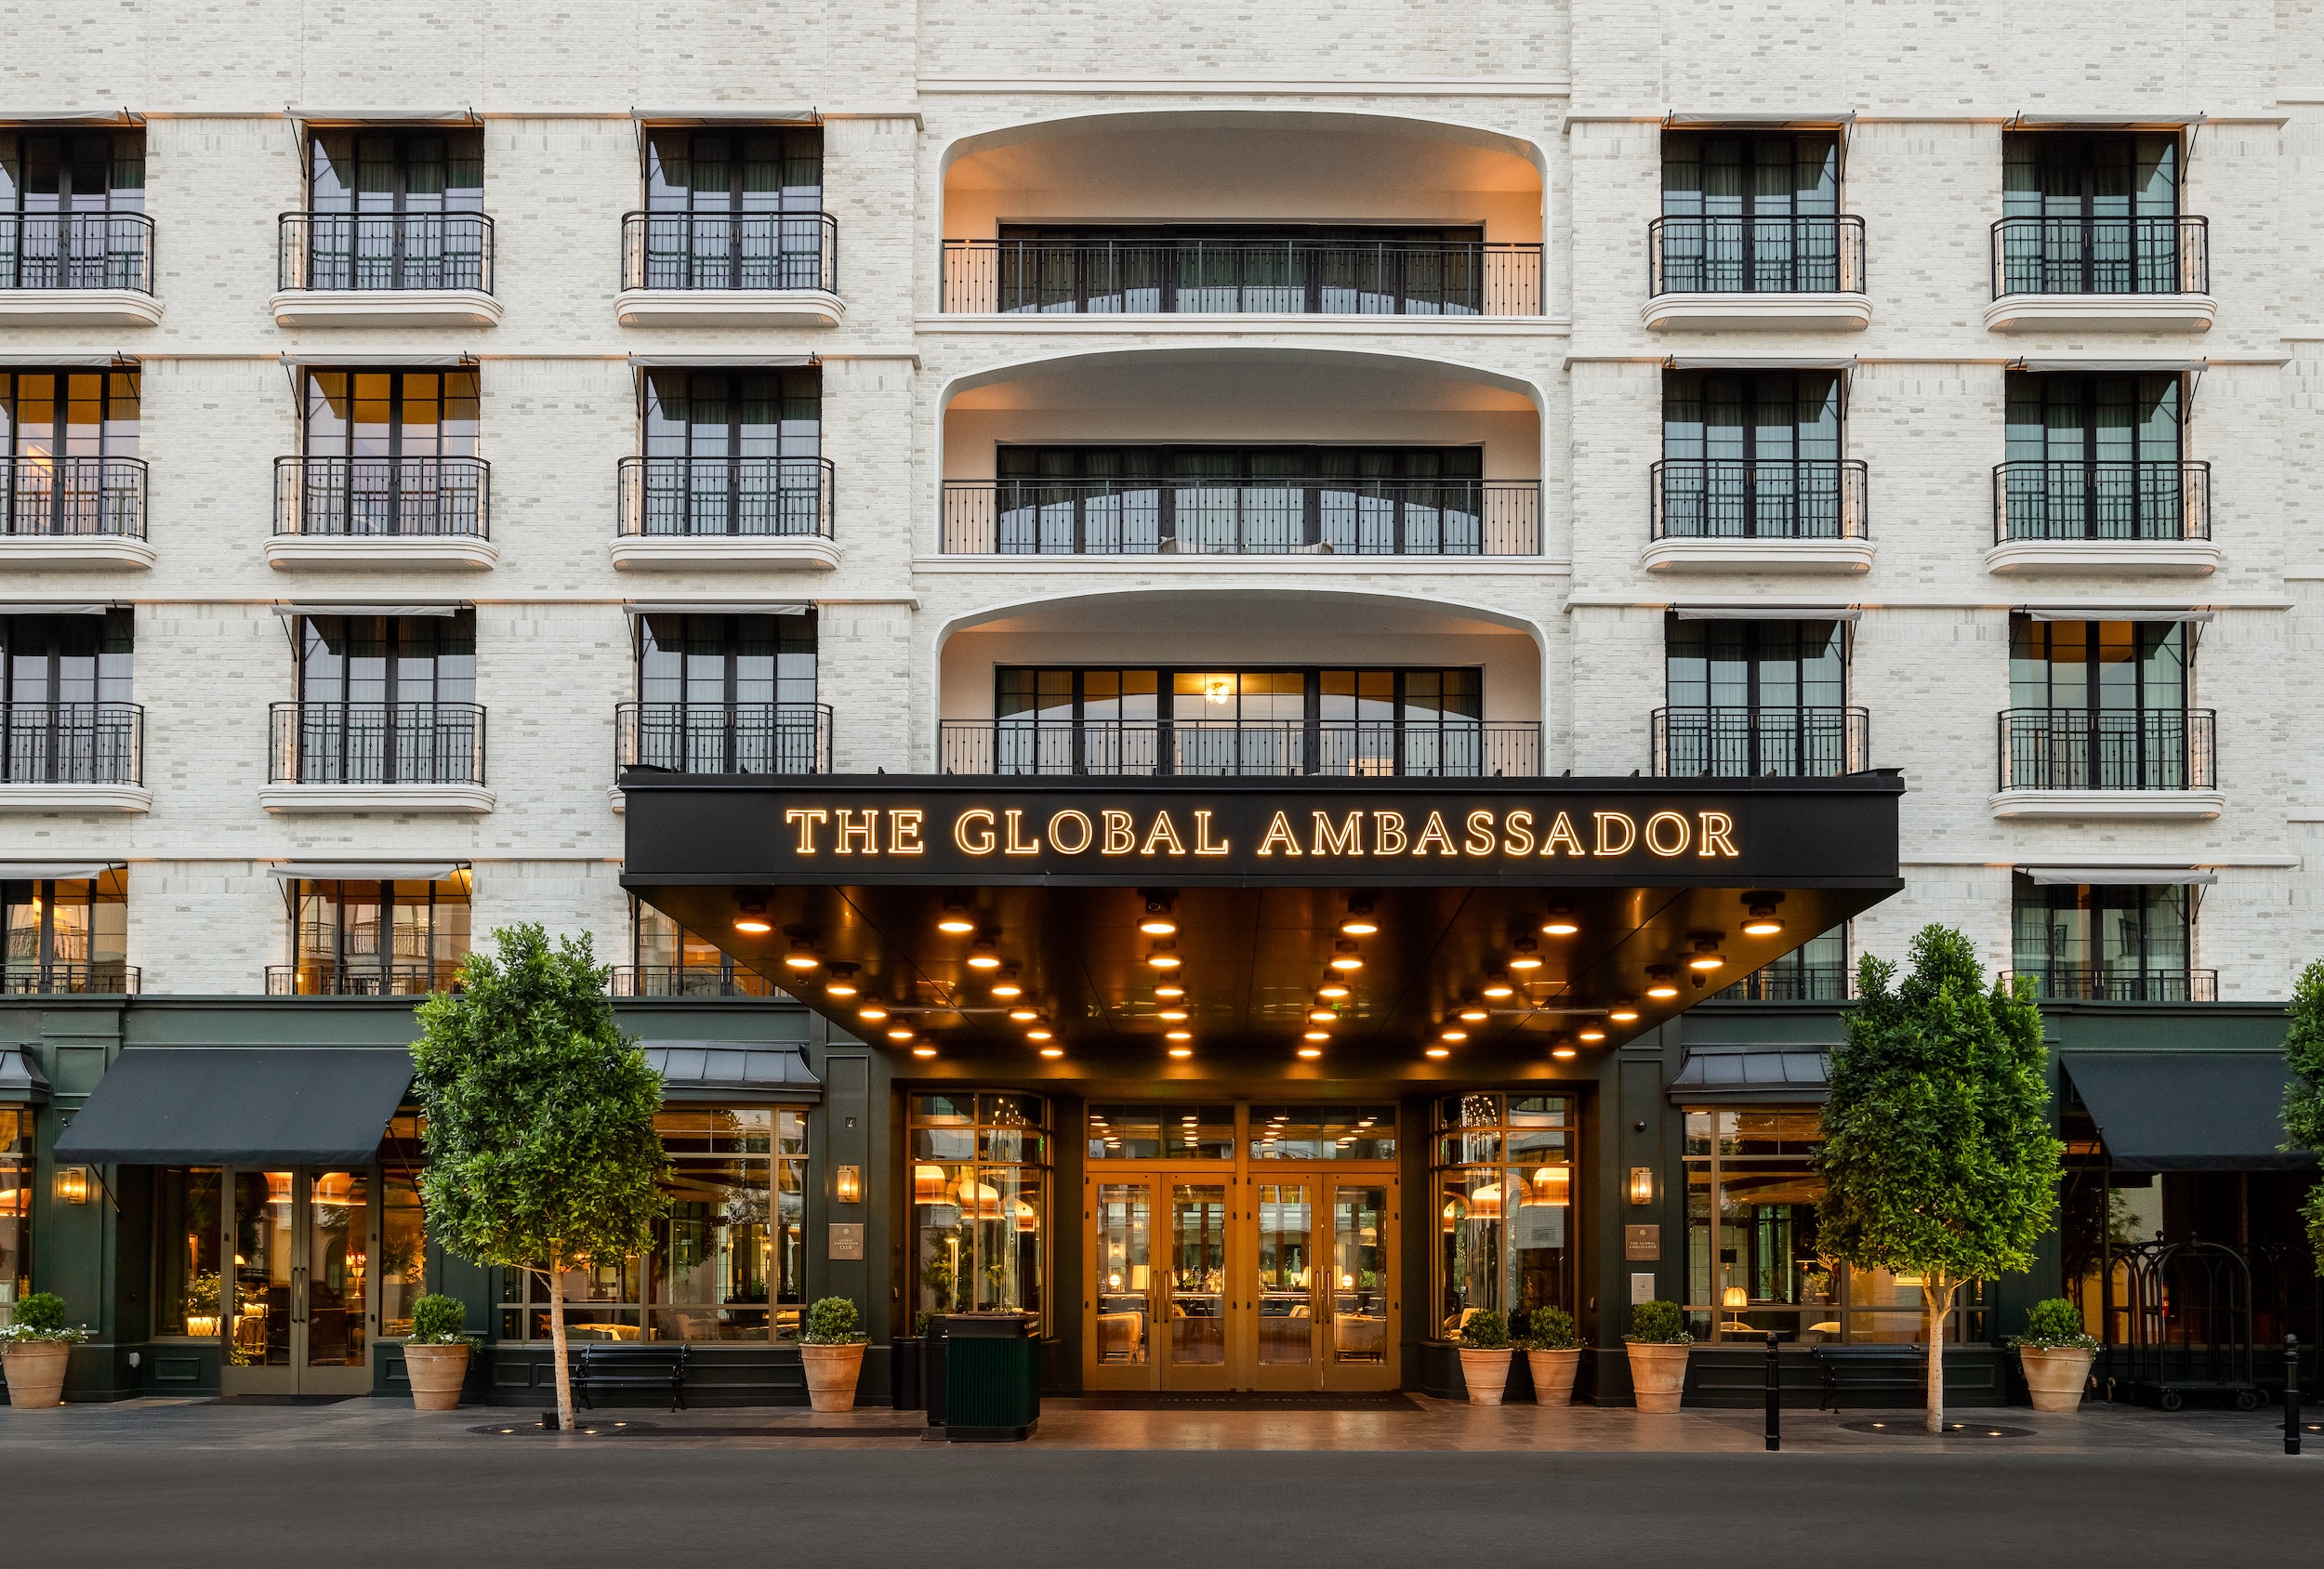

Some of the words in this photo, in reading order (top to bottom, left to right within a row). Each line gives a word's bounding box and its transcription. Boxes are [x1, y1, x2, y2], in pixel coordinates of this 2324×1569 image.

[786, 809, 923, 855] THE
[954, 809, 1229, 855] GLOBAL
[1257, 810, 1738, 857] AMBASSADOR
